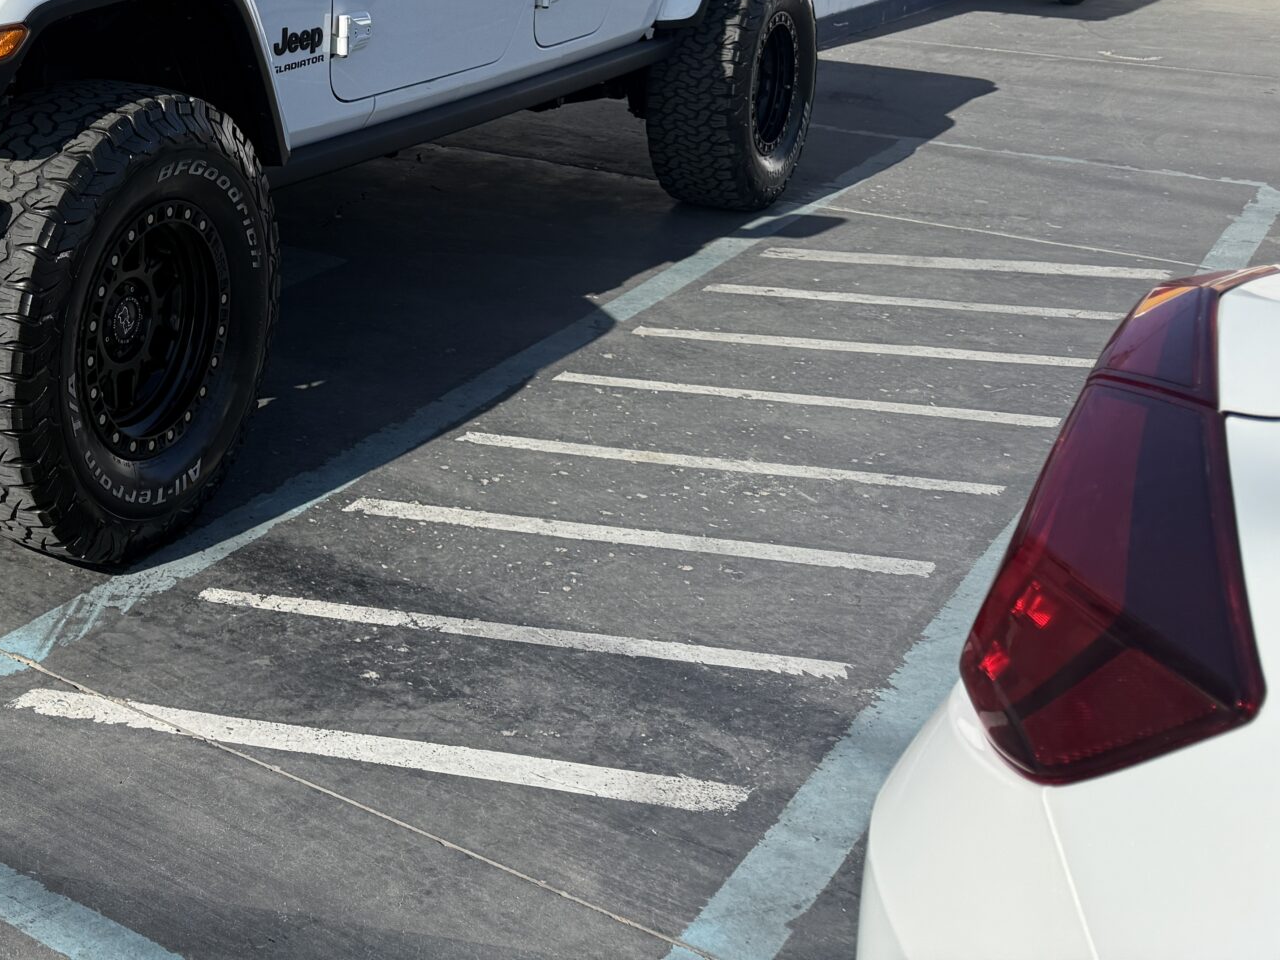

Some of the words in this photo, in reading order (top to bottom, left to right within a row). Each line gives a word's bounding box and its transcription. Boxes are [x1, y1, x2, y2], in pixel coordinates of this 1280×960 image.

[273, 26, 324, 56] Jeep
[156, 159, 263, 269] BFGoodrich
[83, 449, 202, 506] All-Terrain
